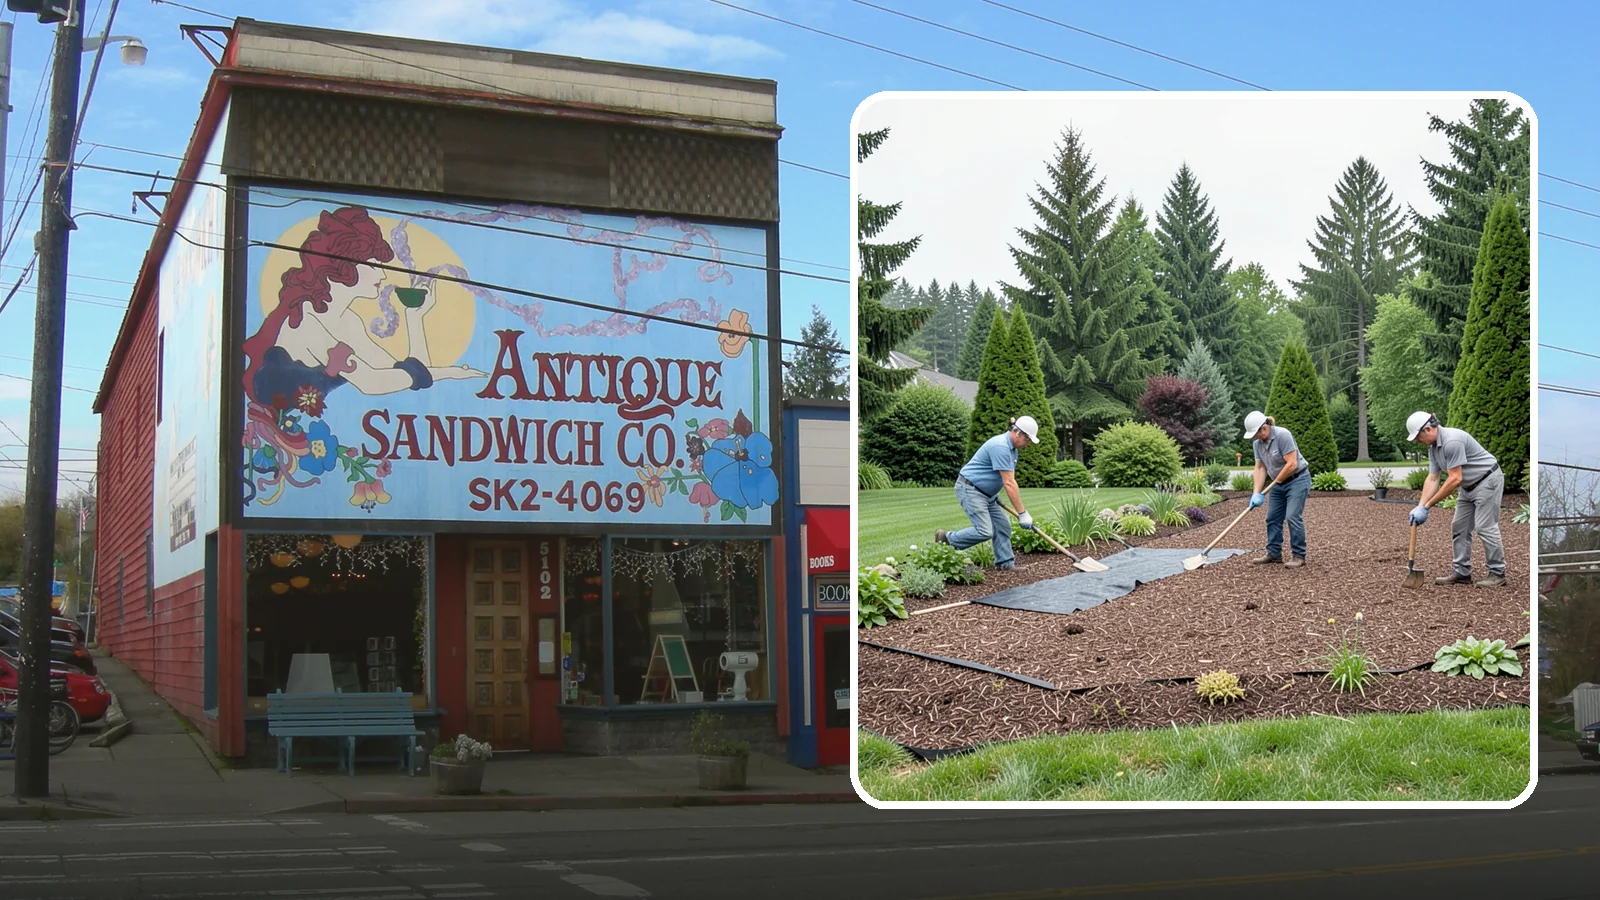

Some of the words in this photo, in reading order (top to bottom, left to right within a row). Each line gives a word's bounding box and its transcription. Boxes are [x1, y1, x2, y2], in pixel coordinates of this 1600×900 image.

[476, 328, 723, 419] ANTIQUE
[361, 408, 604, 467] SANDWICH
[617, 422, 684, 469] CO.
[468, 477, 645, 512] SK2-4069
[540, 542, 551, 599] 5102
[809, 555, 835, 568] BOOKS
